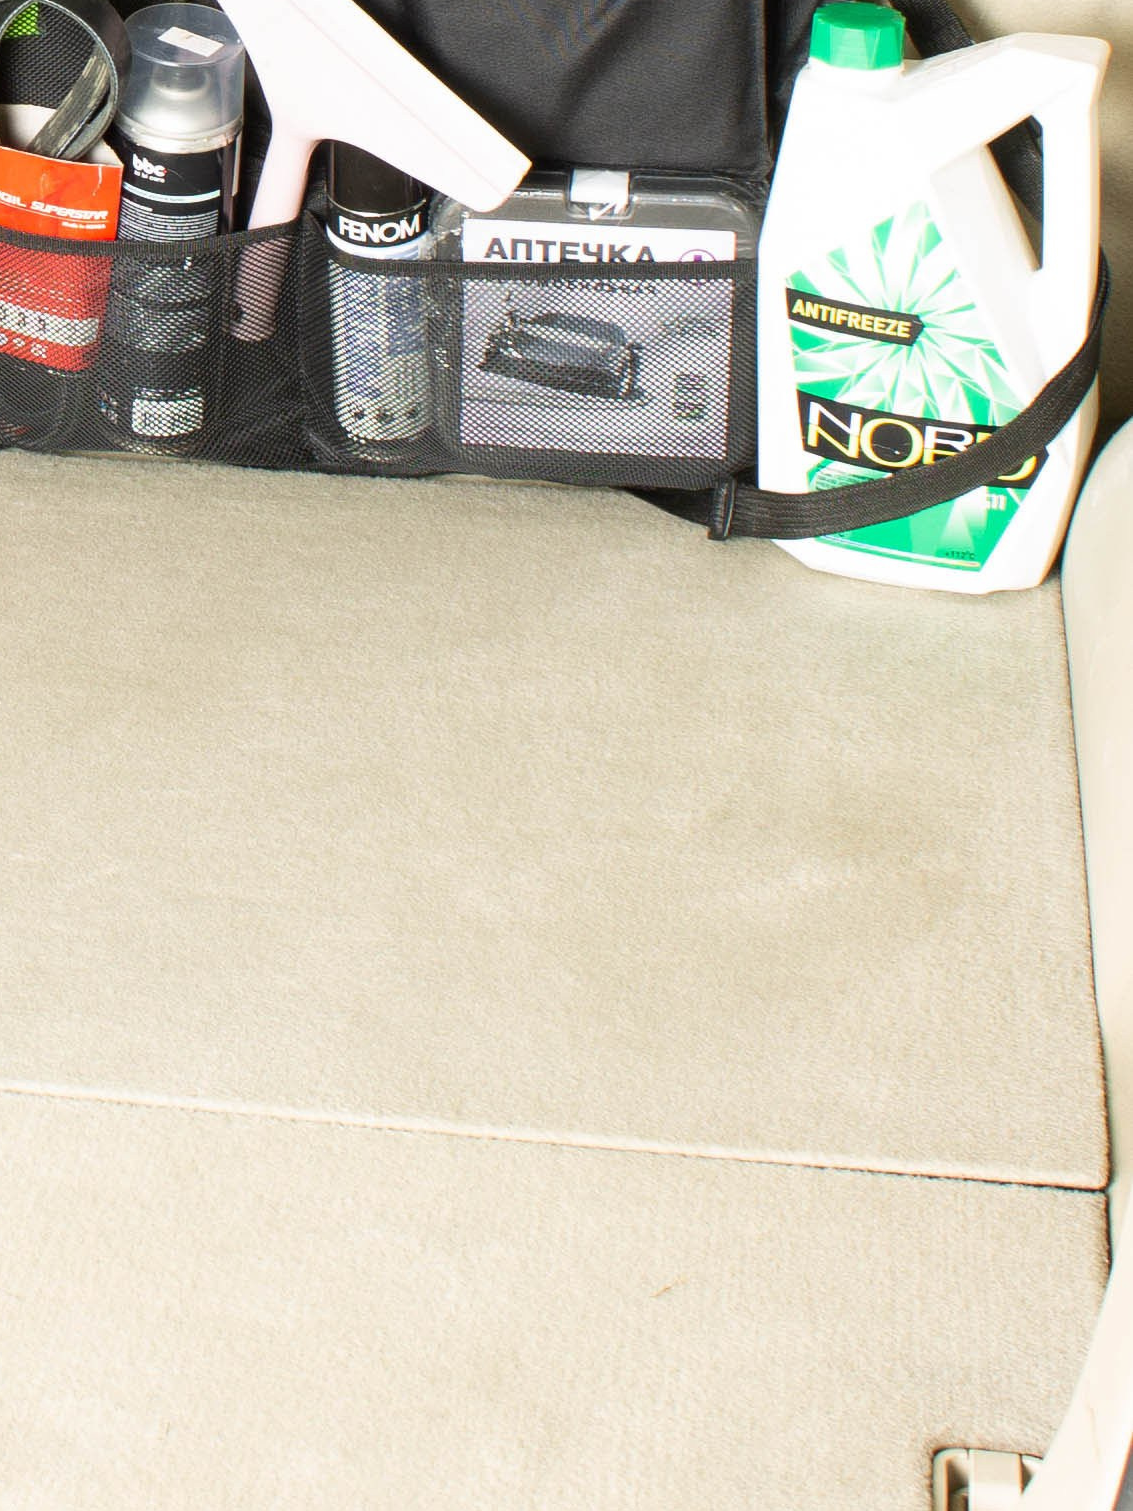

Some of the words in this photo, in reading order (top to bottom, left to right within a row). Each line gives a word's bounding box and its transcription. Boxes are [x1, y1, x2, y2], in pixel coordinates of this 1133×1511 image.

[30, 200, 109, 221] SUPERSTAR
[338, 211, 422, 244] FENOM
[483, 237, 656, 263] АПТЕЧКА
[791, 298, 913, 339] ANTIFREEZE
[806, 400, 1037, 481] NOR
